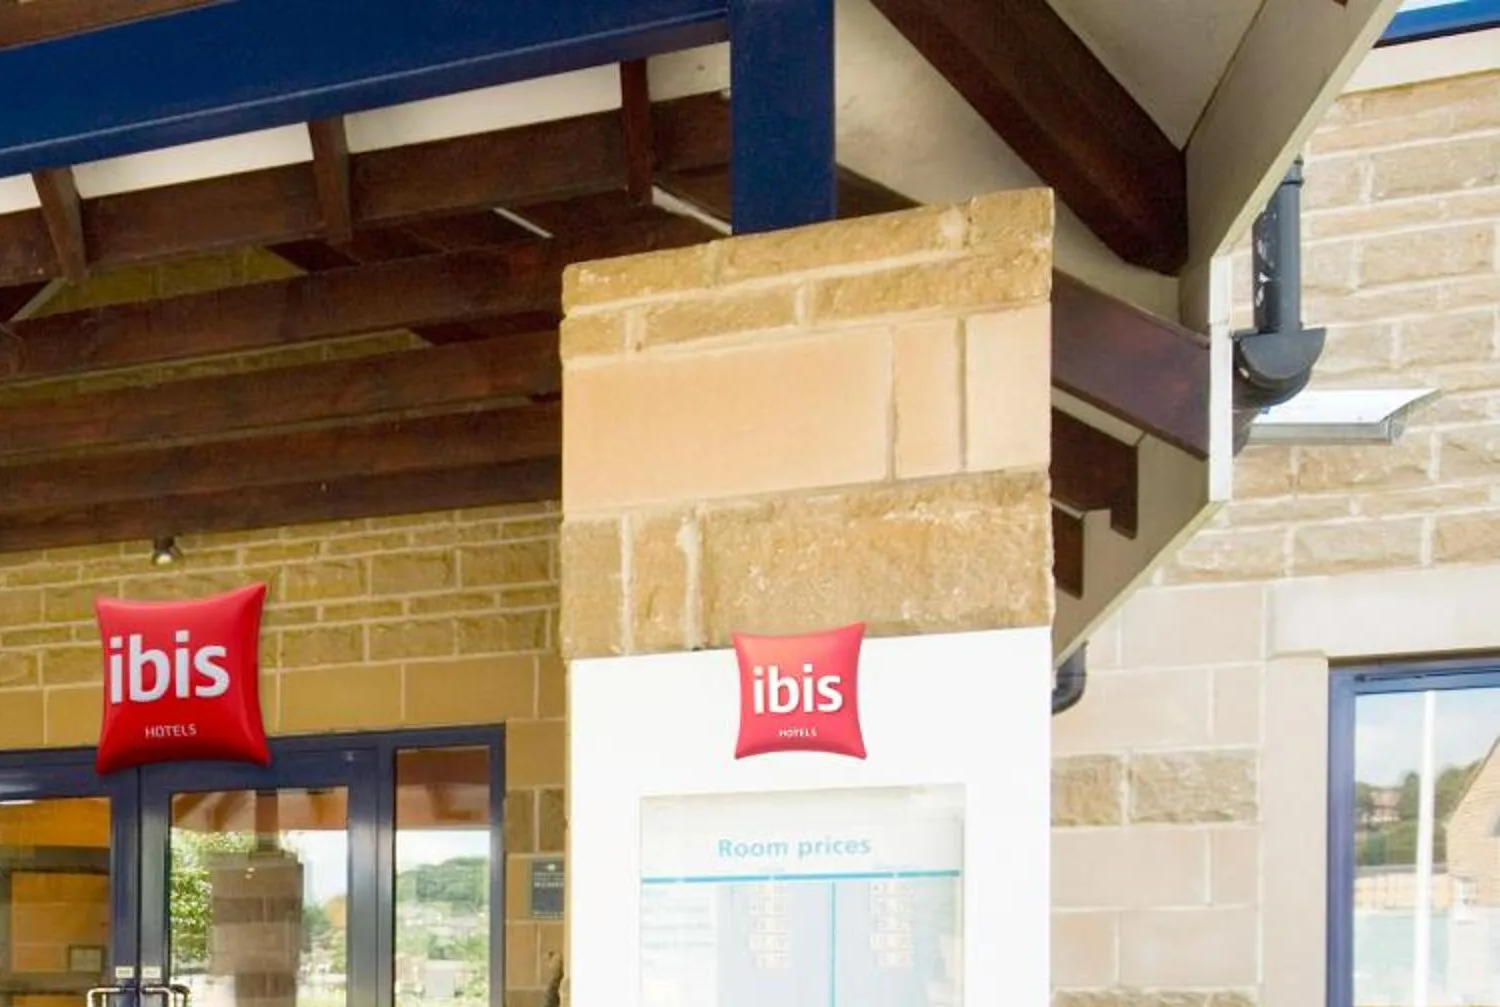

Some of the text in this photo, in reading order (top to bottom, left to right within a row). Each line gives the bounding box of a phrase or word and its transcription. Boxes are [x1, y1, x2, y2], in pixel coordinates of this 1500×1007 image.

[109, 628, 231, 705] ibis
[752, 662, 844, 715] ibis
[144, 723, 198, 738] HOTELS
[778, 727, 819, 738] HOTELS
[718, 836, 872, 860] Room prices
